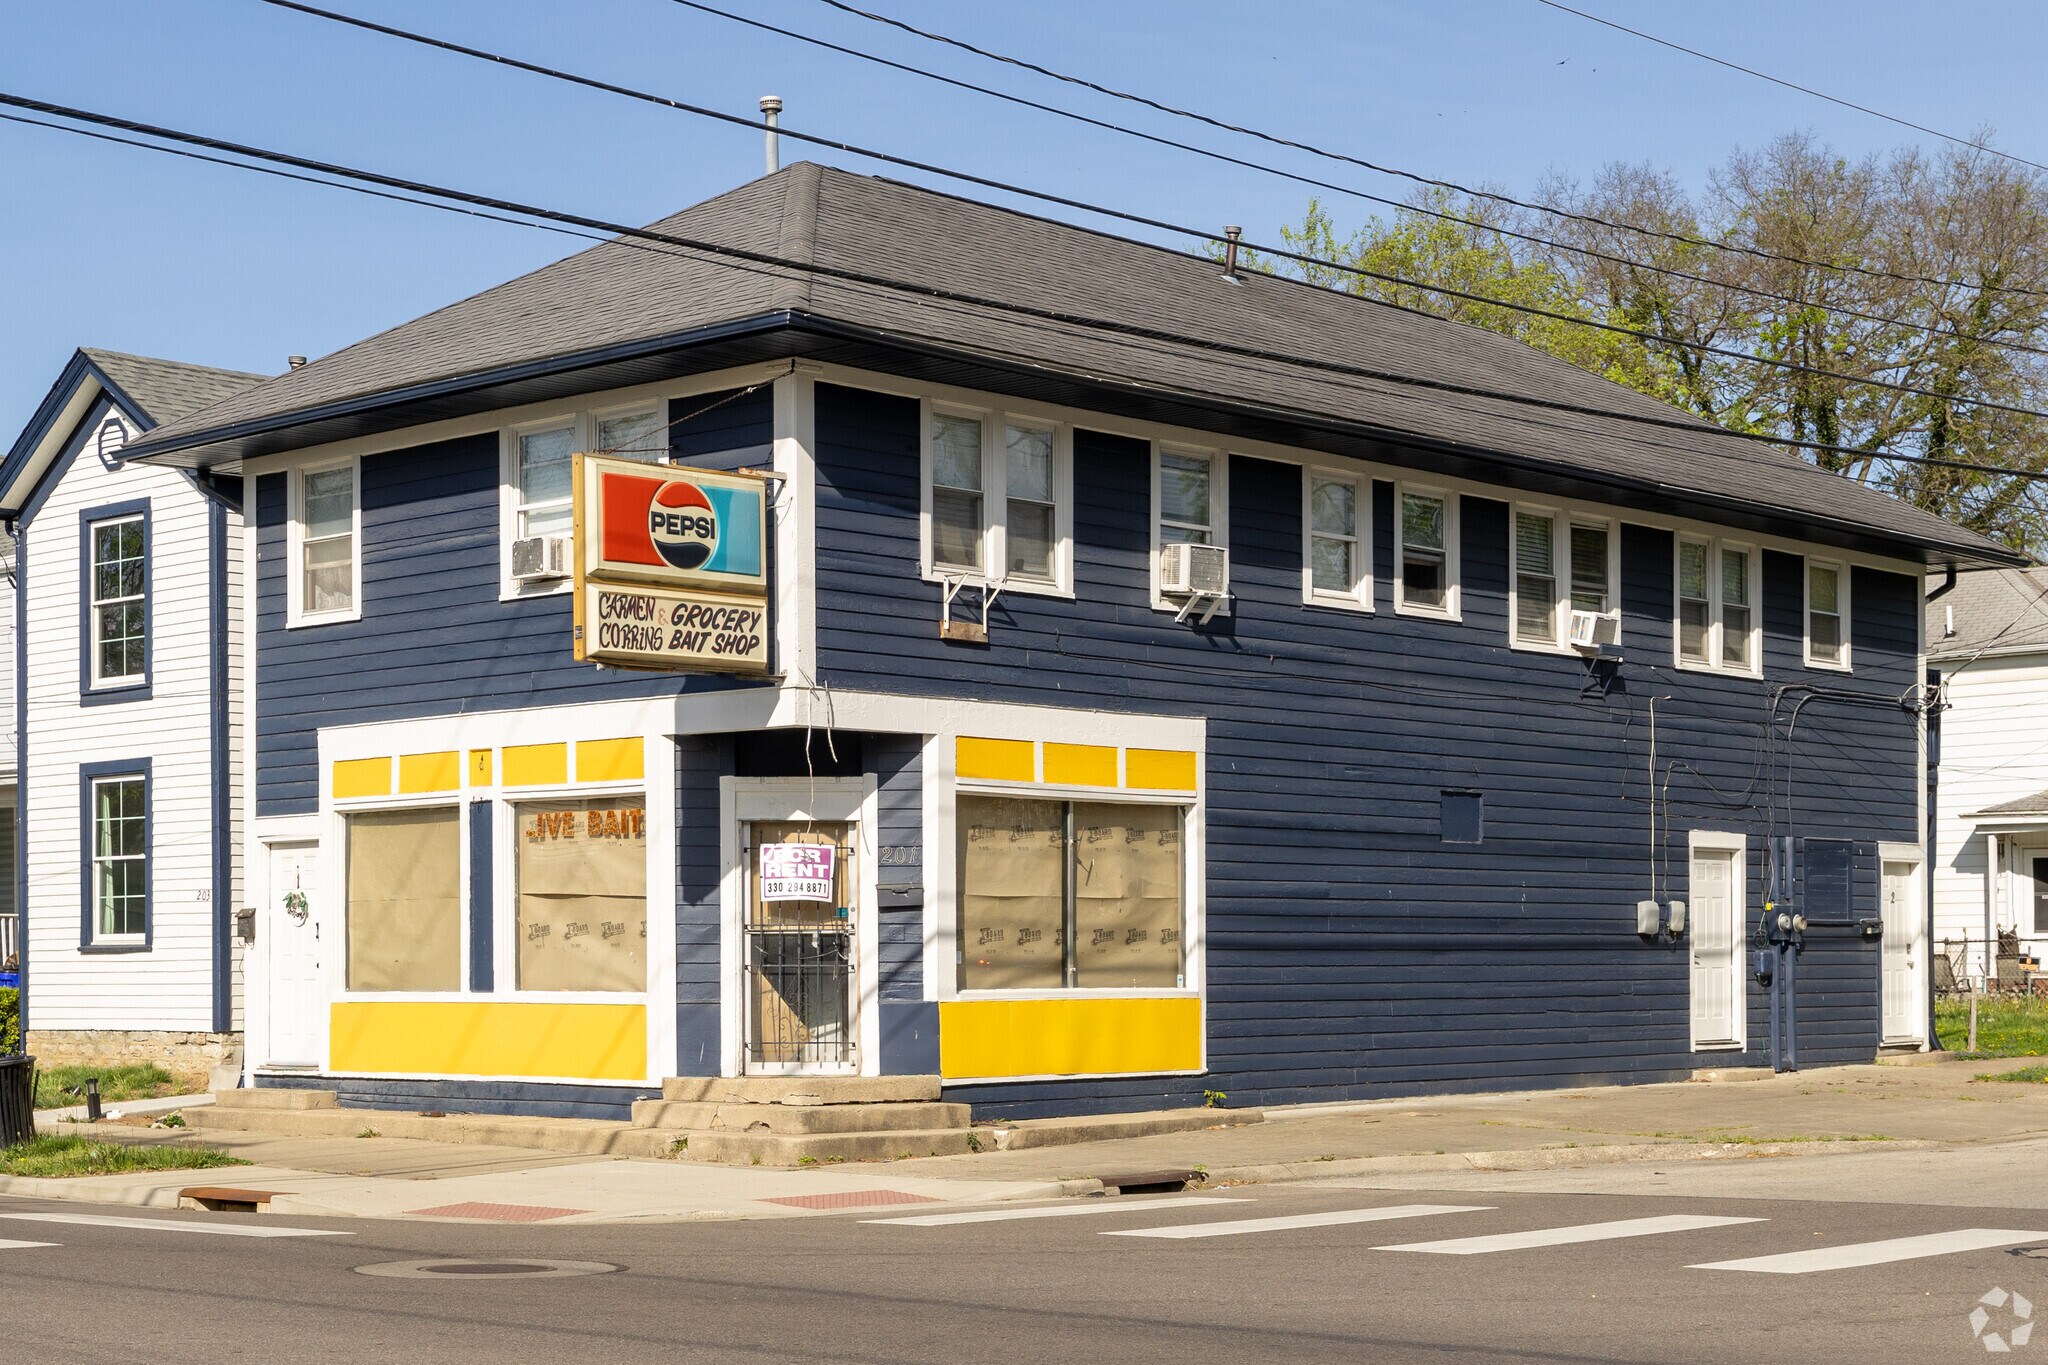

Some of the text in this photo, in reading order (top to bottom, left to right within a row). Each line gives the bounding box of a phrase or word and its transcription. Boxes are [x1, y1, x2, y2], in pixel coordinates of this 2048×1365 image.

[651, 511, 715, 539] PEPSI
[600, 593, 656, 622] CARMEN
[671, 603, 761, 633] GROCERY
[668, 630, 712, 653] BAIT
[711, 633, 760, 656] SHOP
[588, 809, 641, 836] BAIT
[774, 848, 821, 863] FOR
[881, 846, 917, 864] 201
[766, 863, 829, 878] RENT
[196, 889, 210, 901] 203
[768, 882, 827, 894] 330 294 8871
